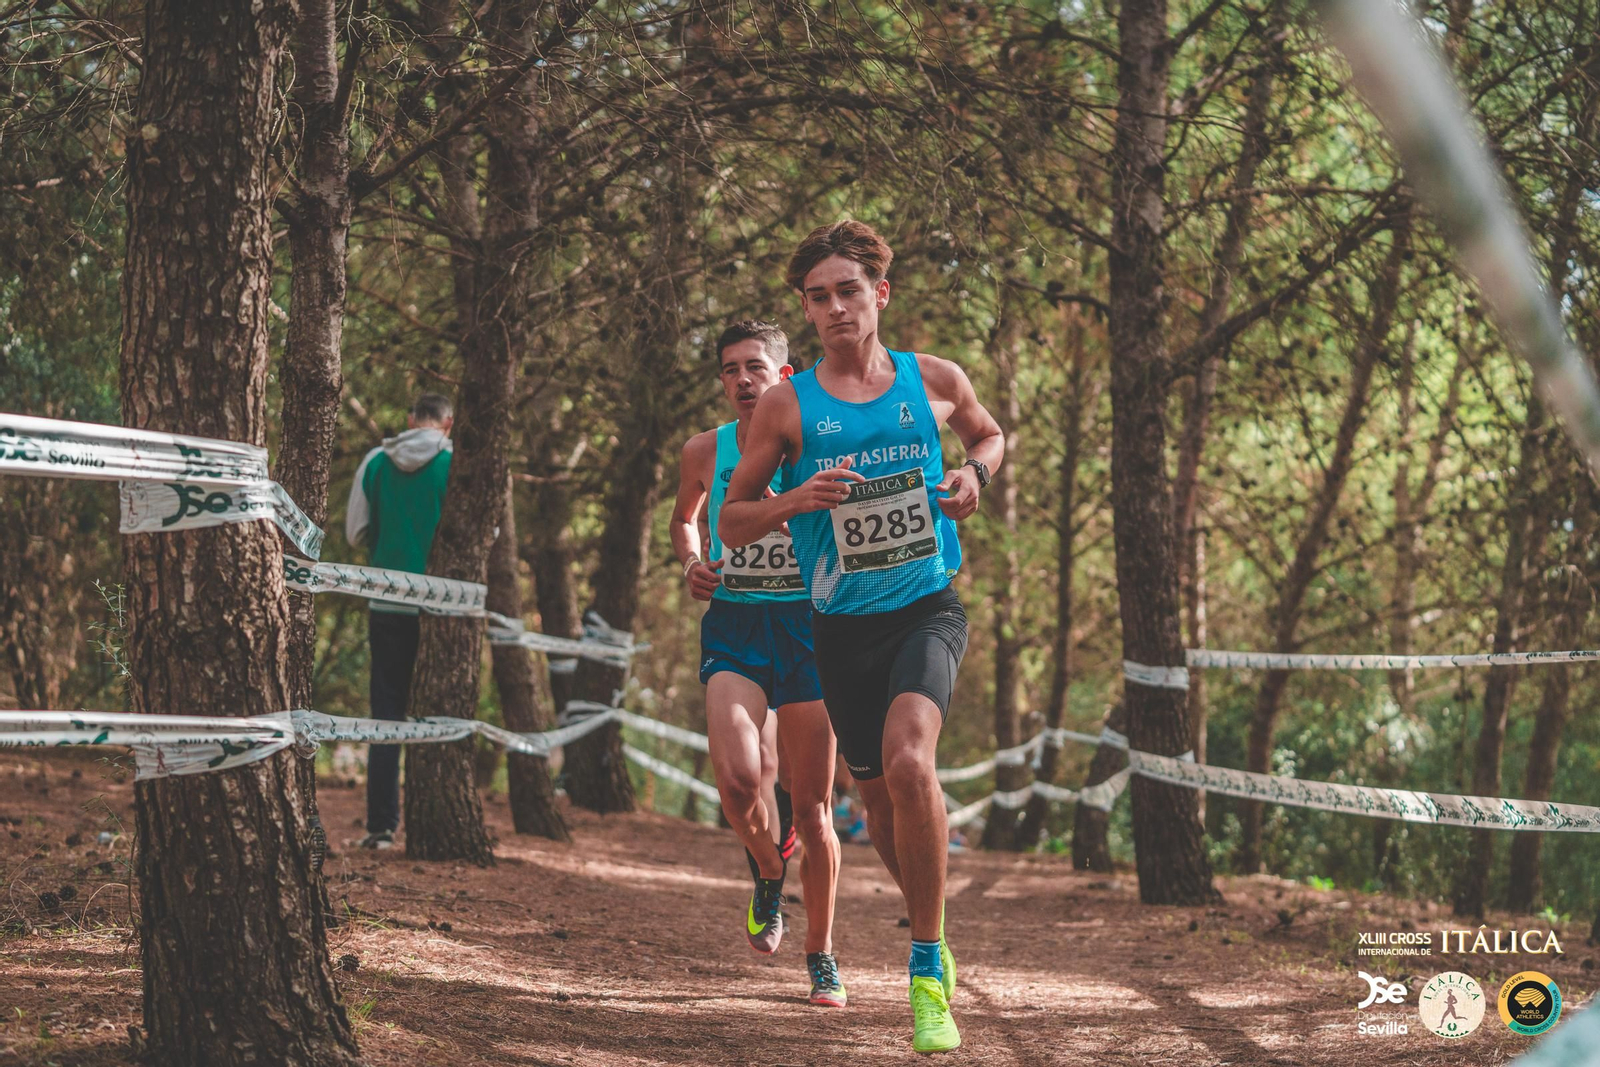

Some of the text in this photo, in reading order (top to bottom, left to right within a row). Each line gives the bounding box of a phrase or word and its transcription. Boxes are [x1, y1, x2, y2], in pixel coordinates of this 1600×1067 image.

[816, 416, 842, 435] als
[815, 442, 930, 473] TROTASIERRA
[855, 478, 902, 497] ITÁLICA
[843, 502, 927, 548] 8285
